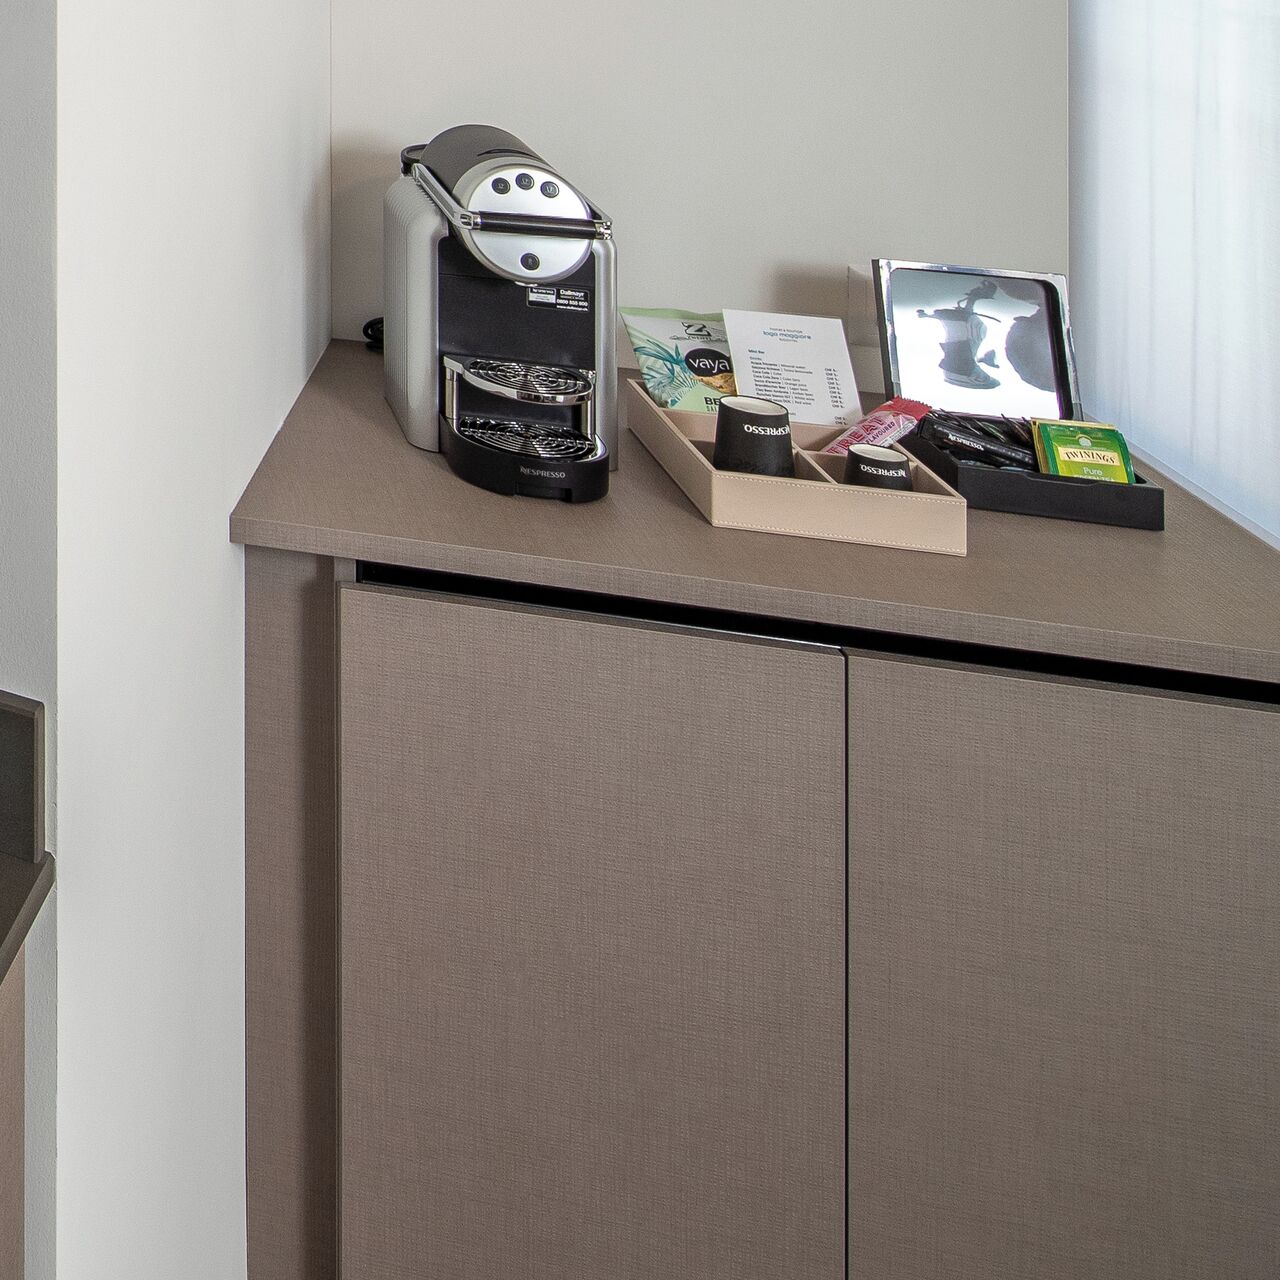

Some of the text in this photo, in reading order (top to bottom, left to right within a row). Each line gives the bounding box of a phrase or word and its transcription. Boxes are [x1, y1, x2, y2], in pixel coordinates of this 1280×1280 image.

[689, 358, 730, 373] vaya
[948, 433, 982, 450] NESPRESSO
[1065, 451, 1116, 464] TWININGS
[520, 465, 566, 478] NESPRESSO
[860, 464, 906, 478] NESPRESSO
[1083, 467, 1103, 475] Pure
